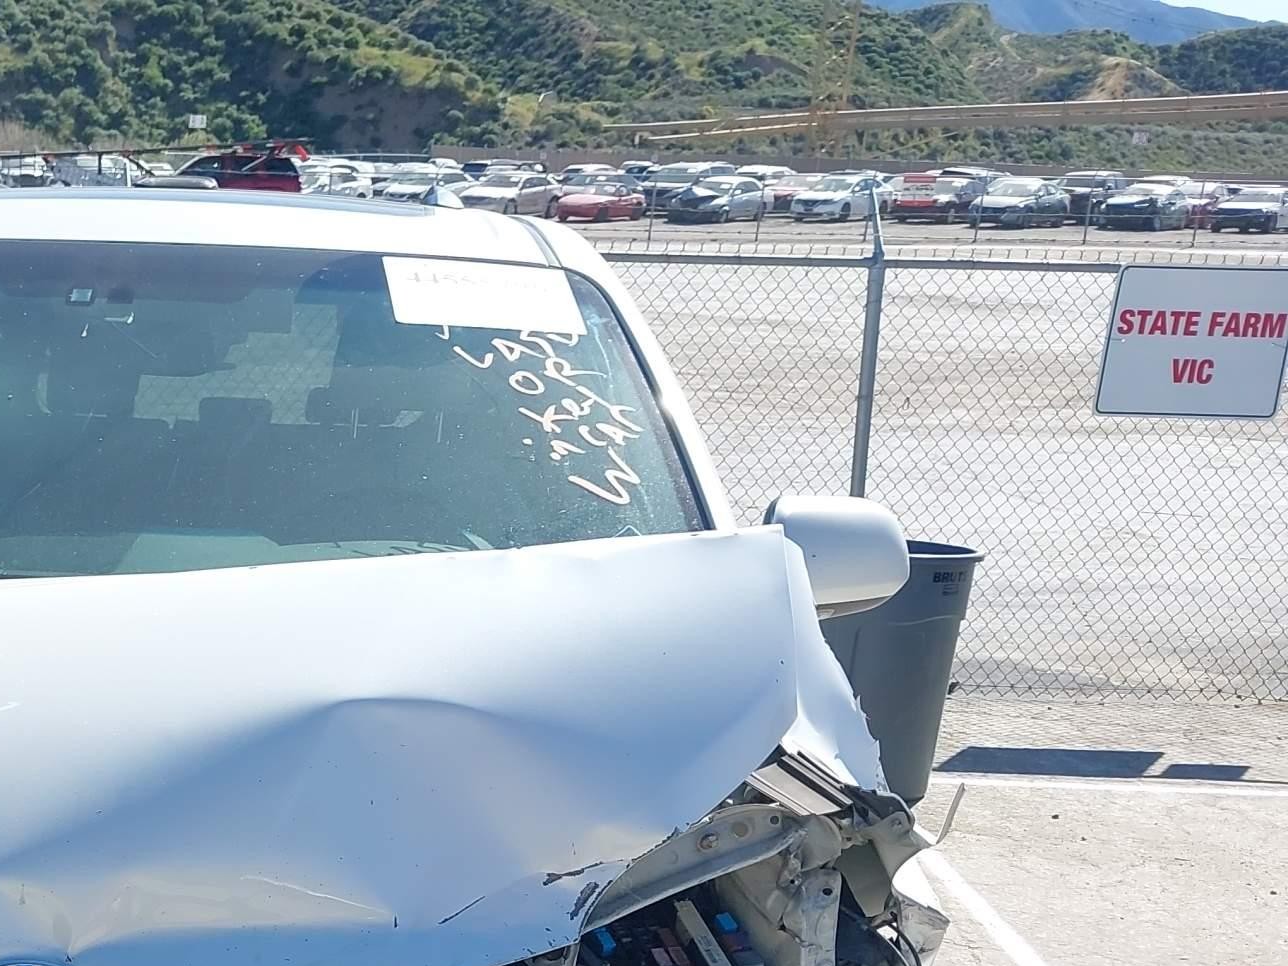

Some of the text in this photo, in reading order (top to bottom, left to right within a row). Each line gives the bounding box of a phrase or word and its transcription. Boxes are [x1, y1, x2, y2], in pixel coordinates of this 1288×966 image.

[1117, 309, 1288, 339] STATE FARM
[1172, 358, 1215, 385] VIC
